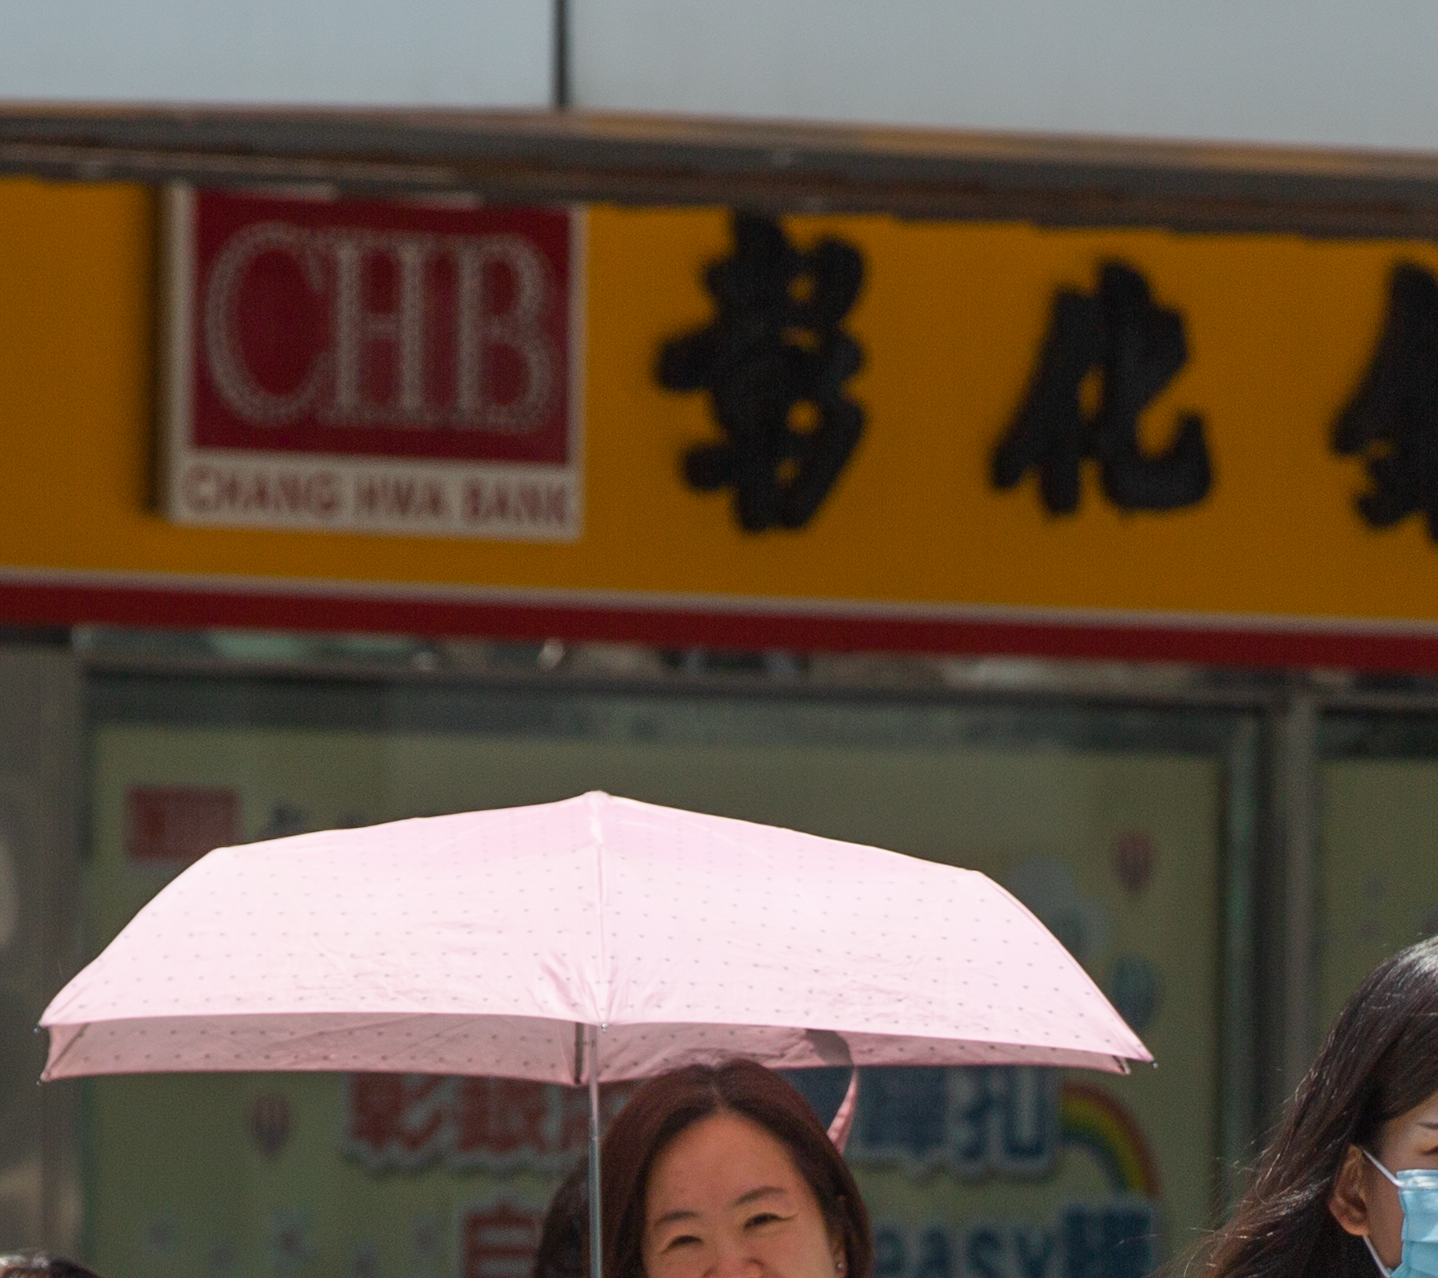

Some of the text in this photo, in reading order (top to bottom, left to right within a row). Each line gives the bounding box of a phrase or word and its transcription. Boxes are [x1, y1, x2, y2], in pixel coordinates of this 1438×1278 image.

[204, 219, 556, 438] CHB
[183, 466, 570, 530] CHANG HWA BANK
